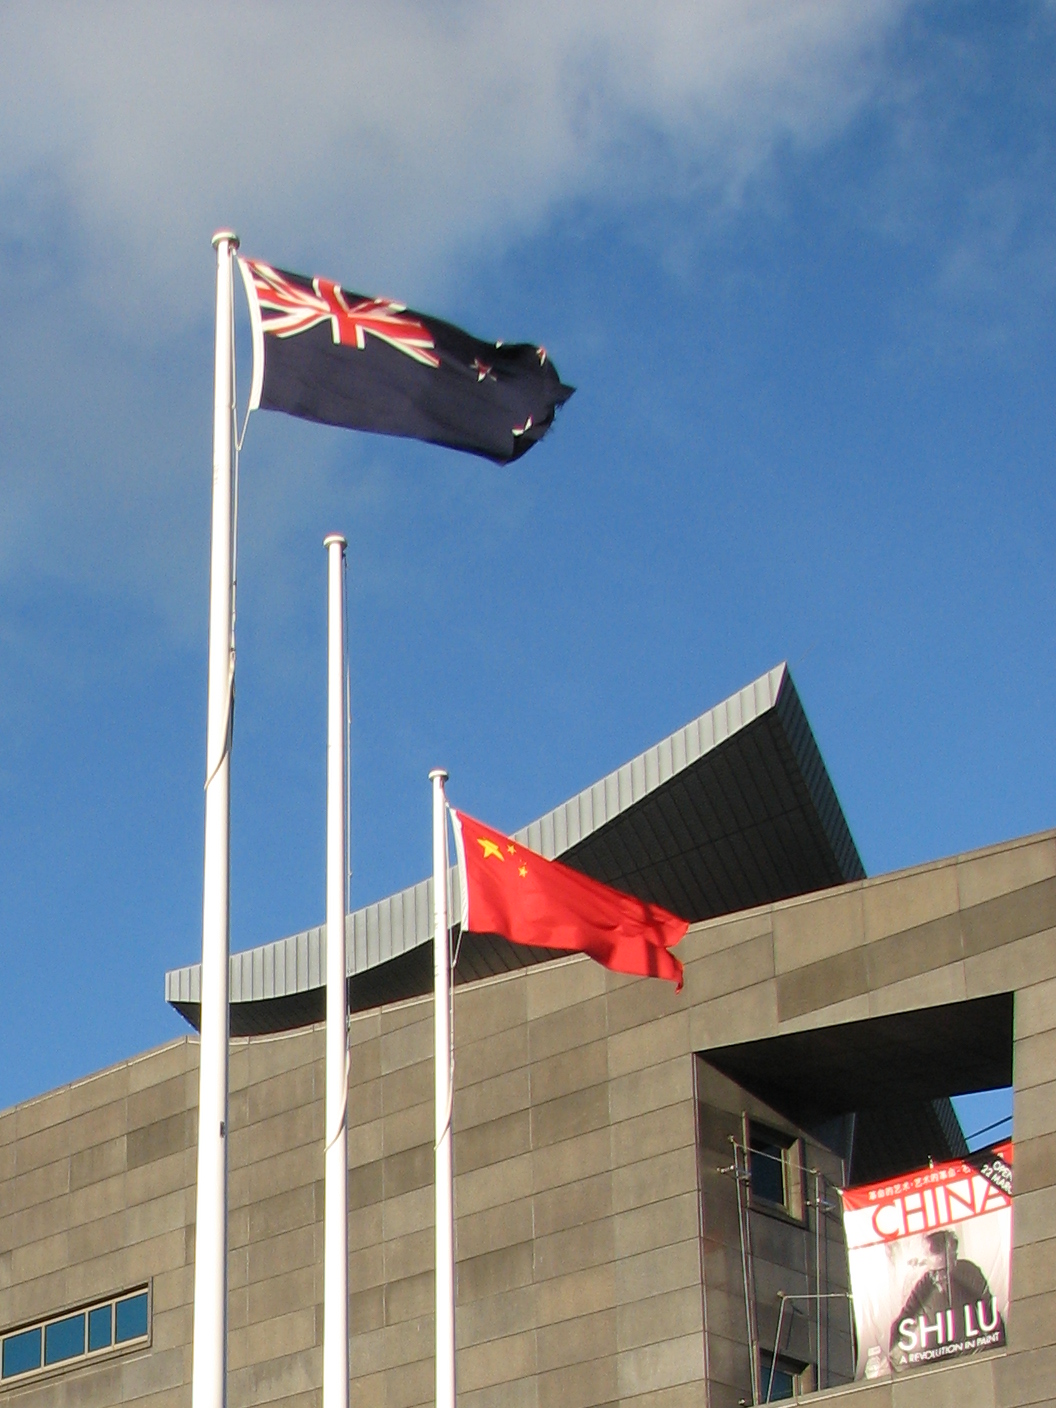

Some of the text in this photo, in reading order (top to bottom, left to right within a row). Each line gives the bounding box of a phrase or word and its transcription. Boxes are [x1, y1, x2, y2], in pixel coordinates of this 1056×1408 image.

[981, 1163, 994, 1178] 22
[872, 1176, 1012, 1240] CHINA
[898, 1296, 999, 1351] SHI LU
[899, 1331, 1001, 1365] A REVOLUTION IN PAINT
